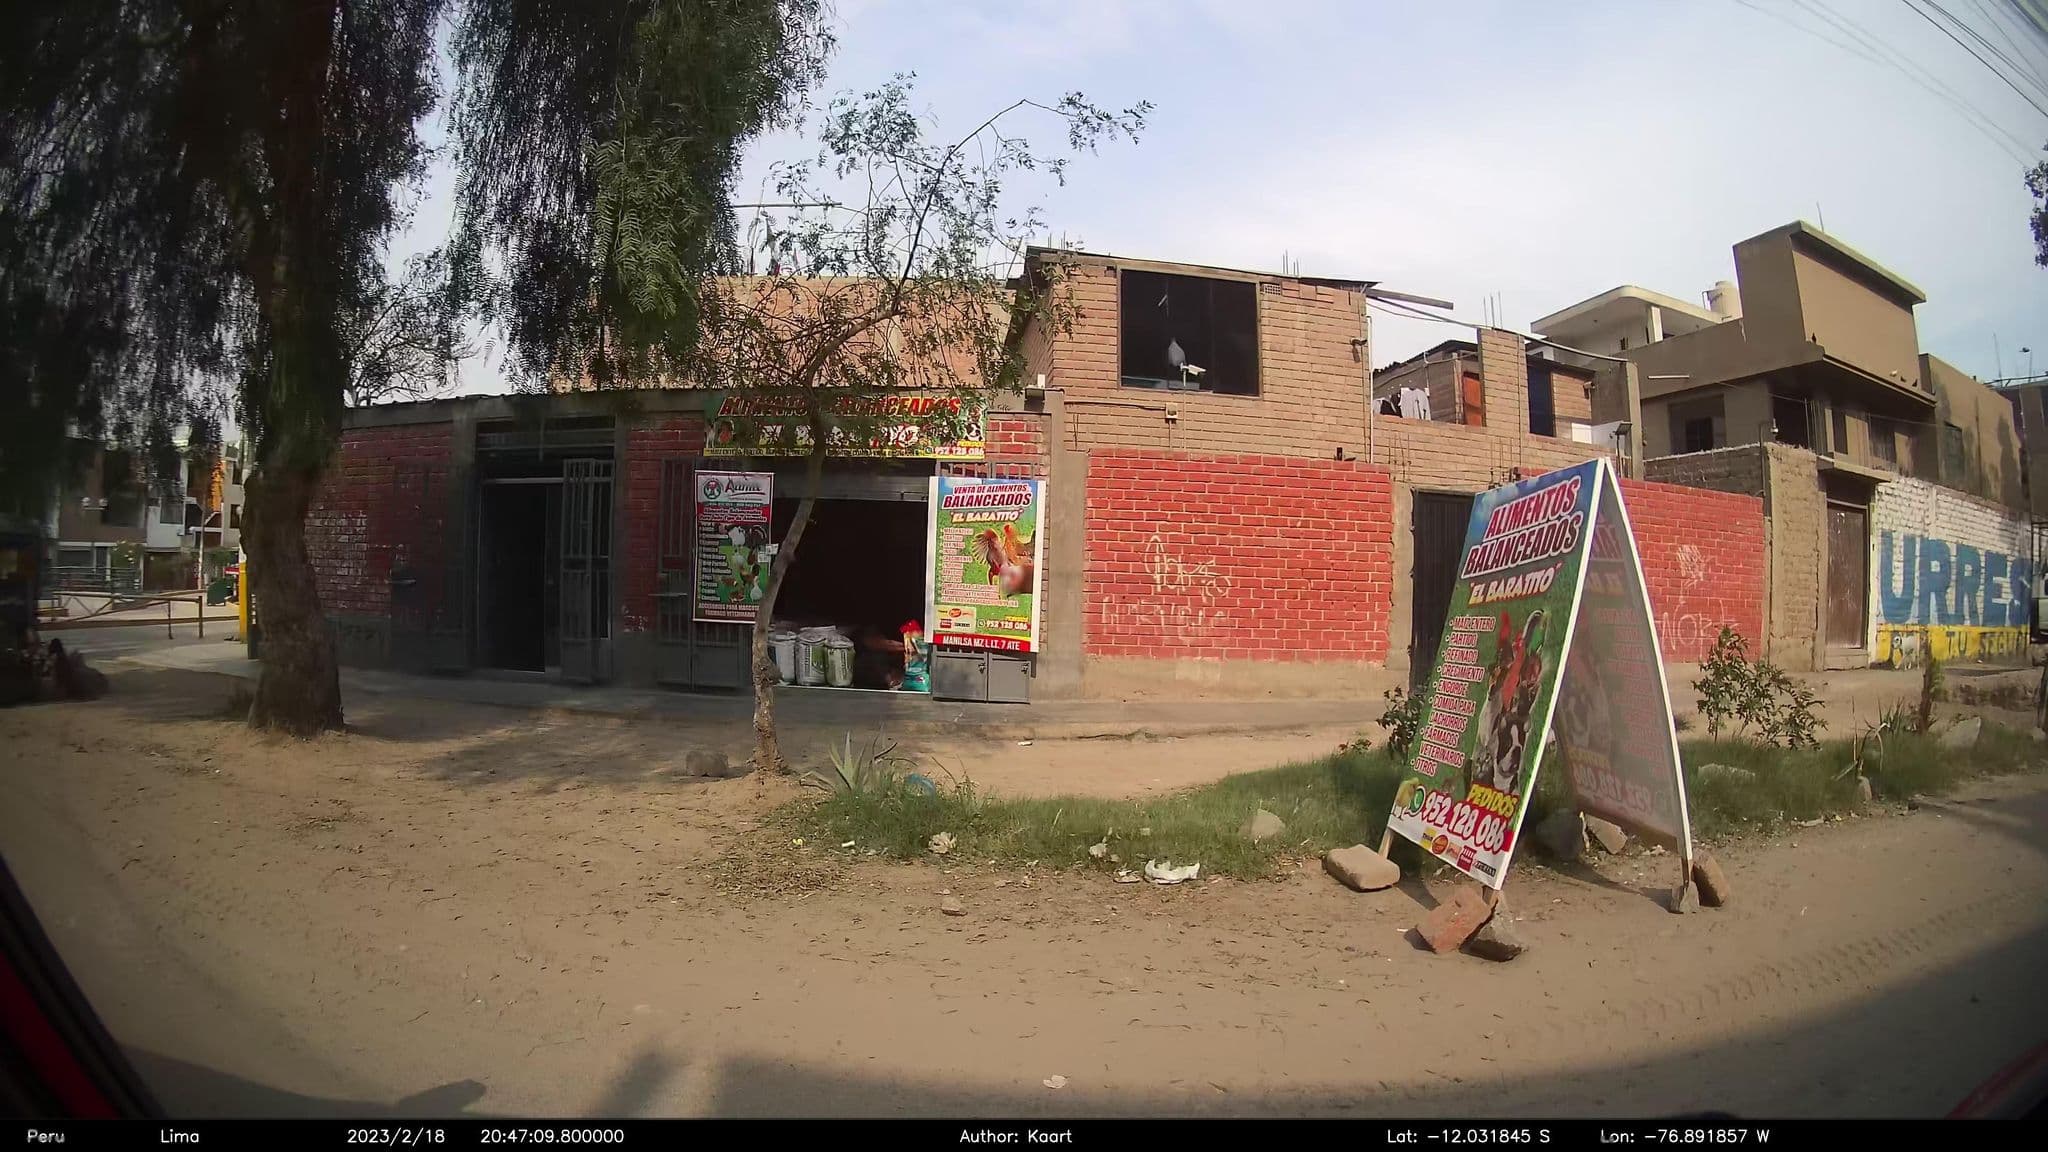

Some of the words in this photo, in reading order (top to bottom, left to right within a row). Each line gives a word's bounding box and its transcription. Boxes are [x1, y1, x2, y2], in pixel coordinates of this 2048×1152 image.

[935, 447, 949, 455] 952
[952, 447, 966, 455] 128
[968, 447, 984, 455] 086
[954, 485, 975, 494] VENTA
[976, 485, 985, 493] DE
[986, 483, 1028, 493] ALIMENTOS
[942, 492, 1032, 509] BALANCEADOS
[1482, 475, 1581, 542] ALIMENTOS
[1461, 511, 1583, 579] BALANCEADOS
[986, 620, 999, 628] 952
[1000, 621, 1013, 629] 128
[1014, 622, 1028, 630] 086
[1470, 617, 1496, 631] ENTERO
[943, 635, 972, 647] MANILSA
[973, 637, 984, 647] MZ
[1001, 640, 1006, 649] 7
[1006, 641, 1020, 650] ATE
[1450, 632, 1478, 647] PARTIDO
[1445, 647, 1478, 664] REFINADO
[1441, 663, 1485, 682] CRECIMIENTO
[1437, 678, 1469, 697] ENGORDE
[1432, 694, 1459, 713] COMIDA
[1458, 699, 1476, 716] PARA
[1419, 741, 1465, 768] VETERINARIOS
[1413, 757, 1438, 777] OTROS
[1467, 783, 1518, 818] PEDIDOS
[1422, 791, 1452, 827] 952
[1447, 803, 1479, 840] 128
[1475, 814, 1507, 854] 086
